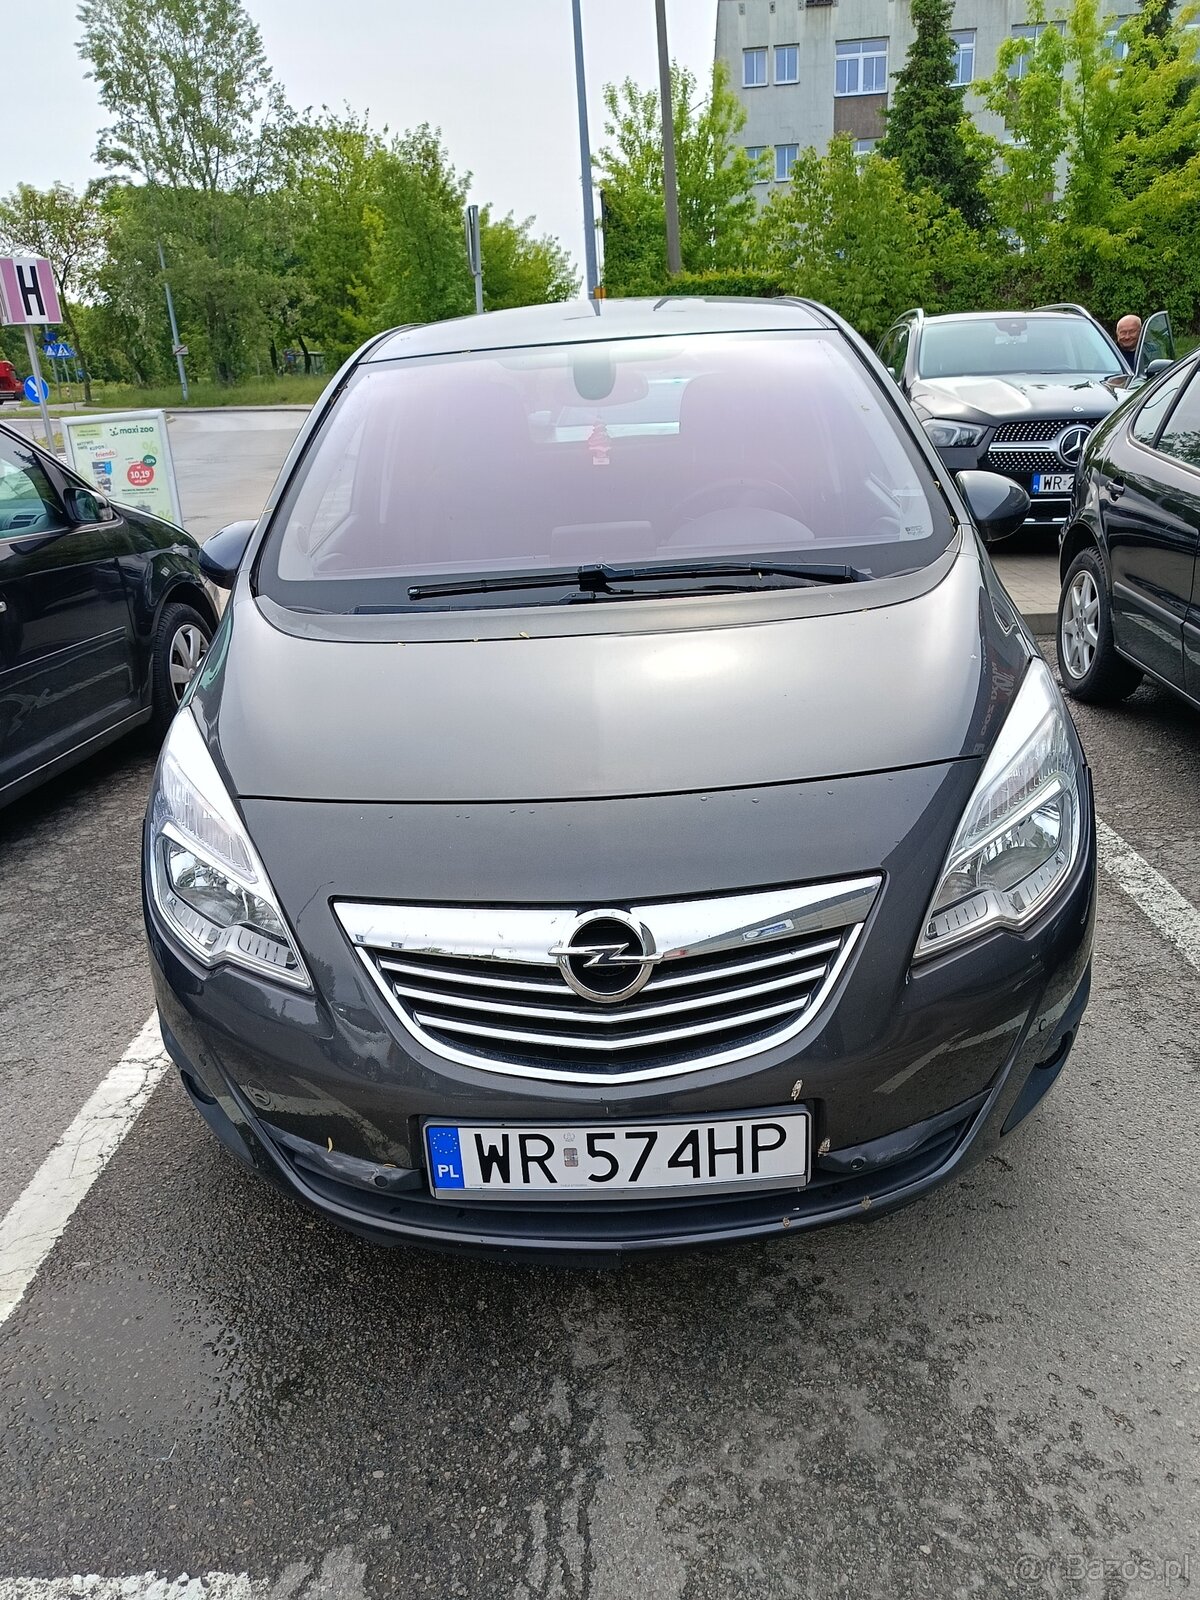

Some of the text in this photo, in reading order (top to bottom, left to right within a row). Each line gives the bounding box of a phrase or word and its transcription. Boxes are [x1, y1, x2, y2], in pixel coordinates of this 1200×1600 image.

[16, 265, 46, 316] H
[119, 425, 139, 434] maxi
[130, 470, 150, 480] 10,19
[1043, 476, 1062, 490] WR
[474, 1123, 787, 1184] WR 574HP
[438, 1164, 459, 1178] PL
